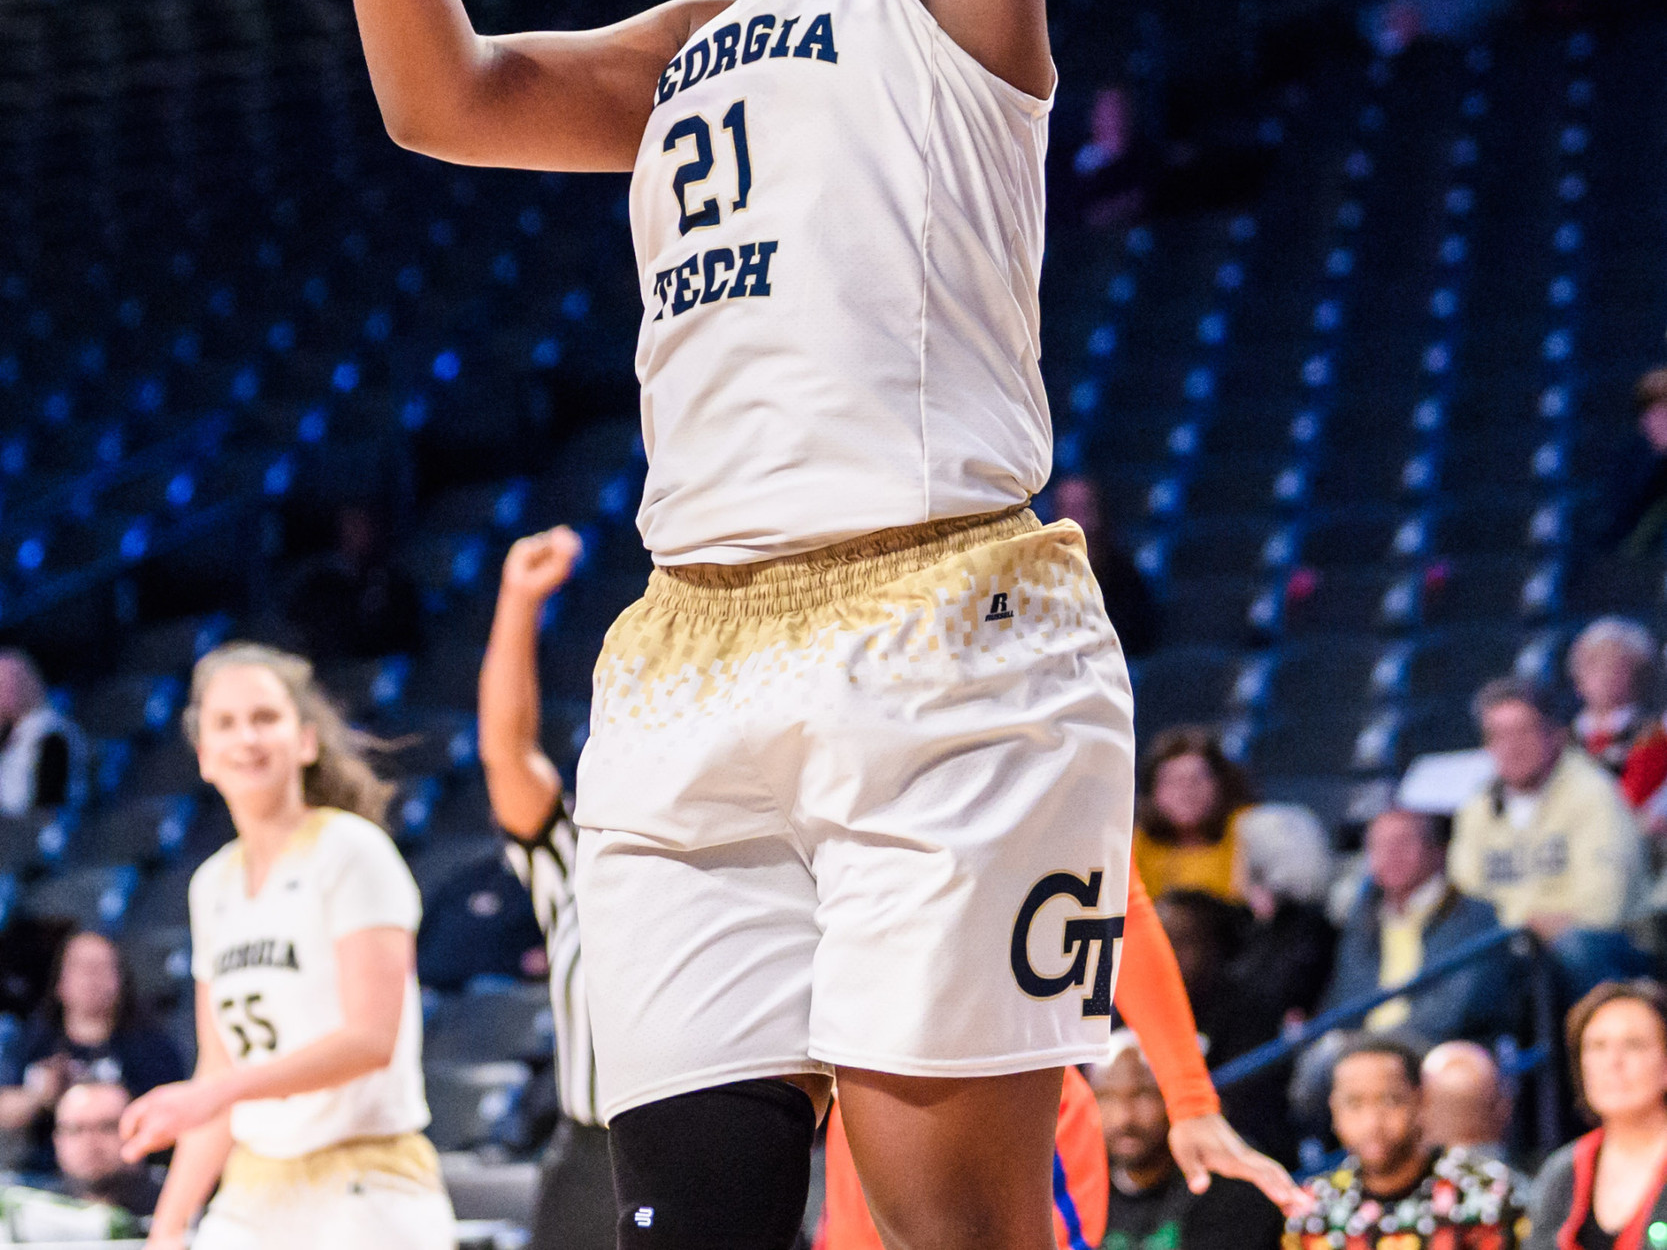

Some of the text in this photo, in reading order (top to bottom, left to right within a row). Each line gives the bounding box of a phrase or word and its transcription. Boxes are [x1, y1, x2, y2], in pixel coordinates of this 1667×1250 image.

[655, 12, 839, 107] EORGIA
[661, 96, 752, 238] 21
[652, 240, 779, 323] TECH
[1010, 867, 1126, 1020] GT
